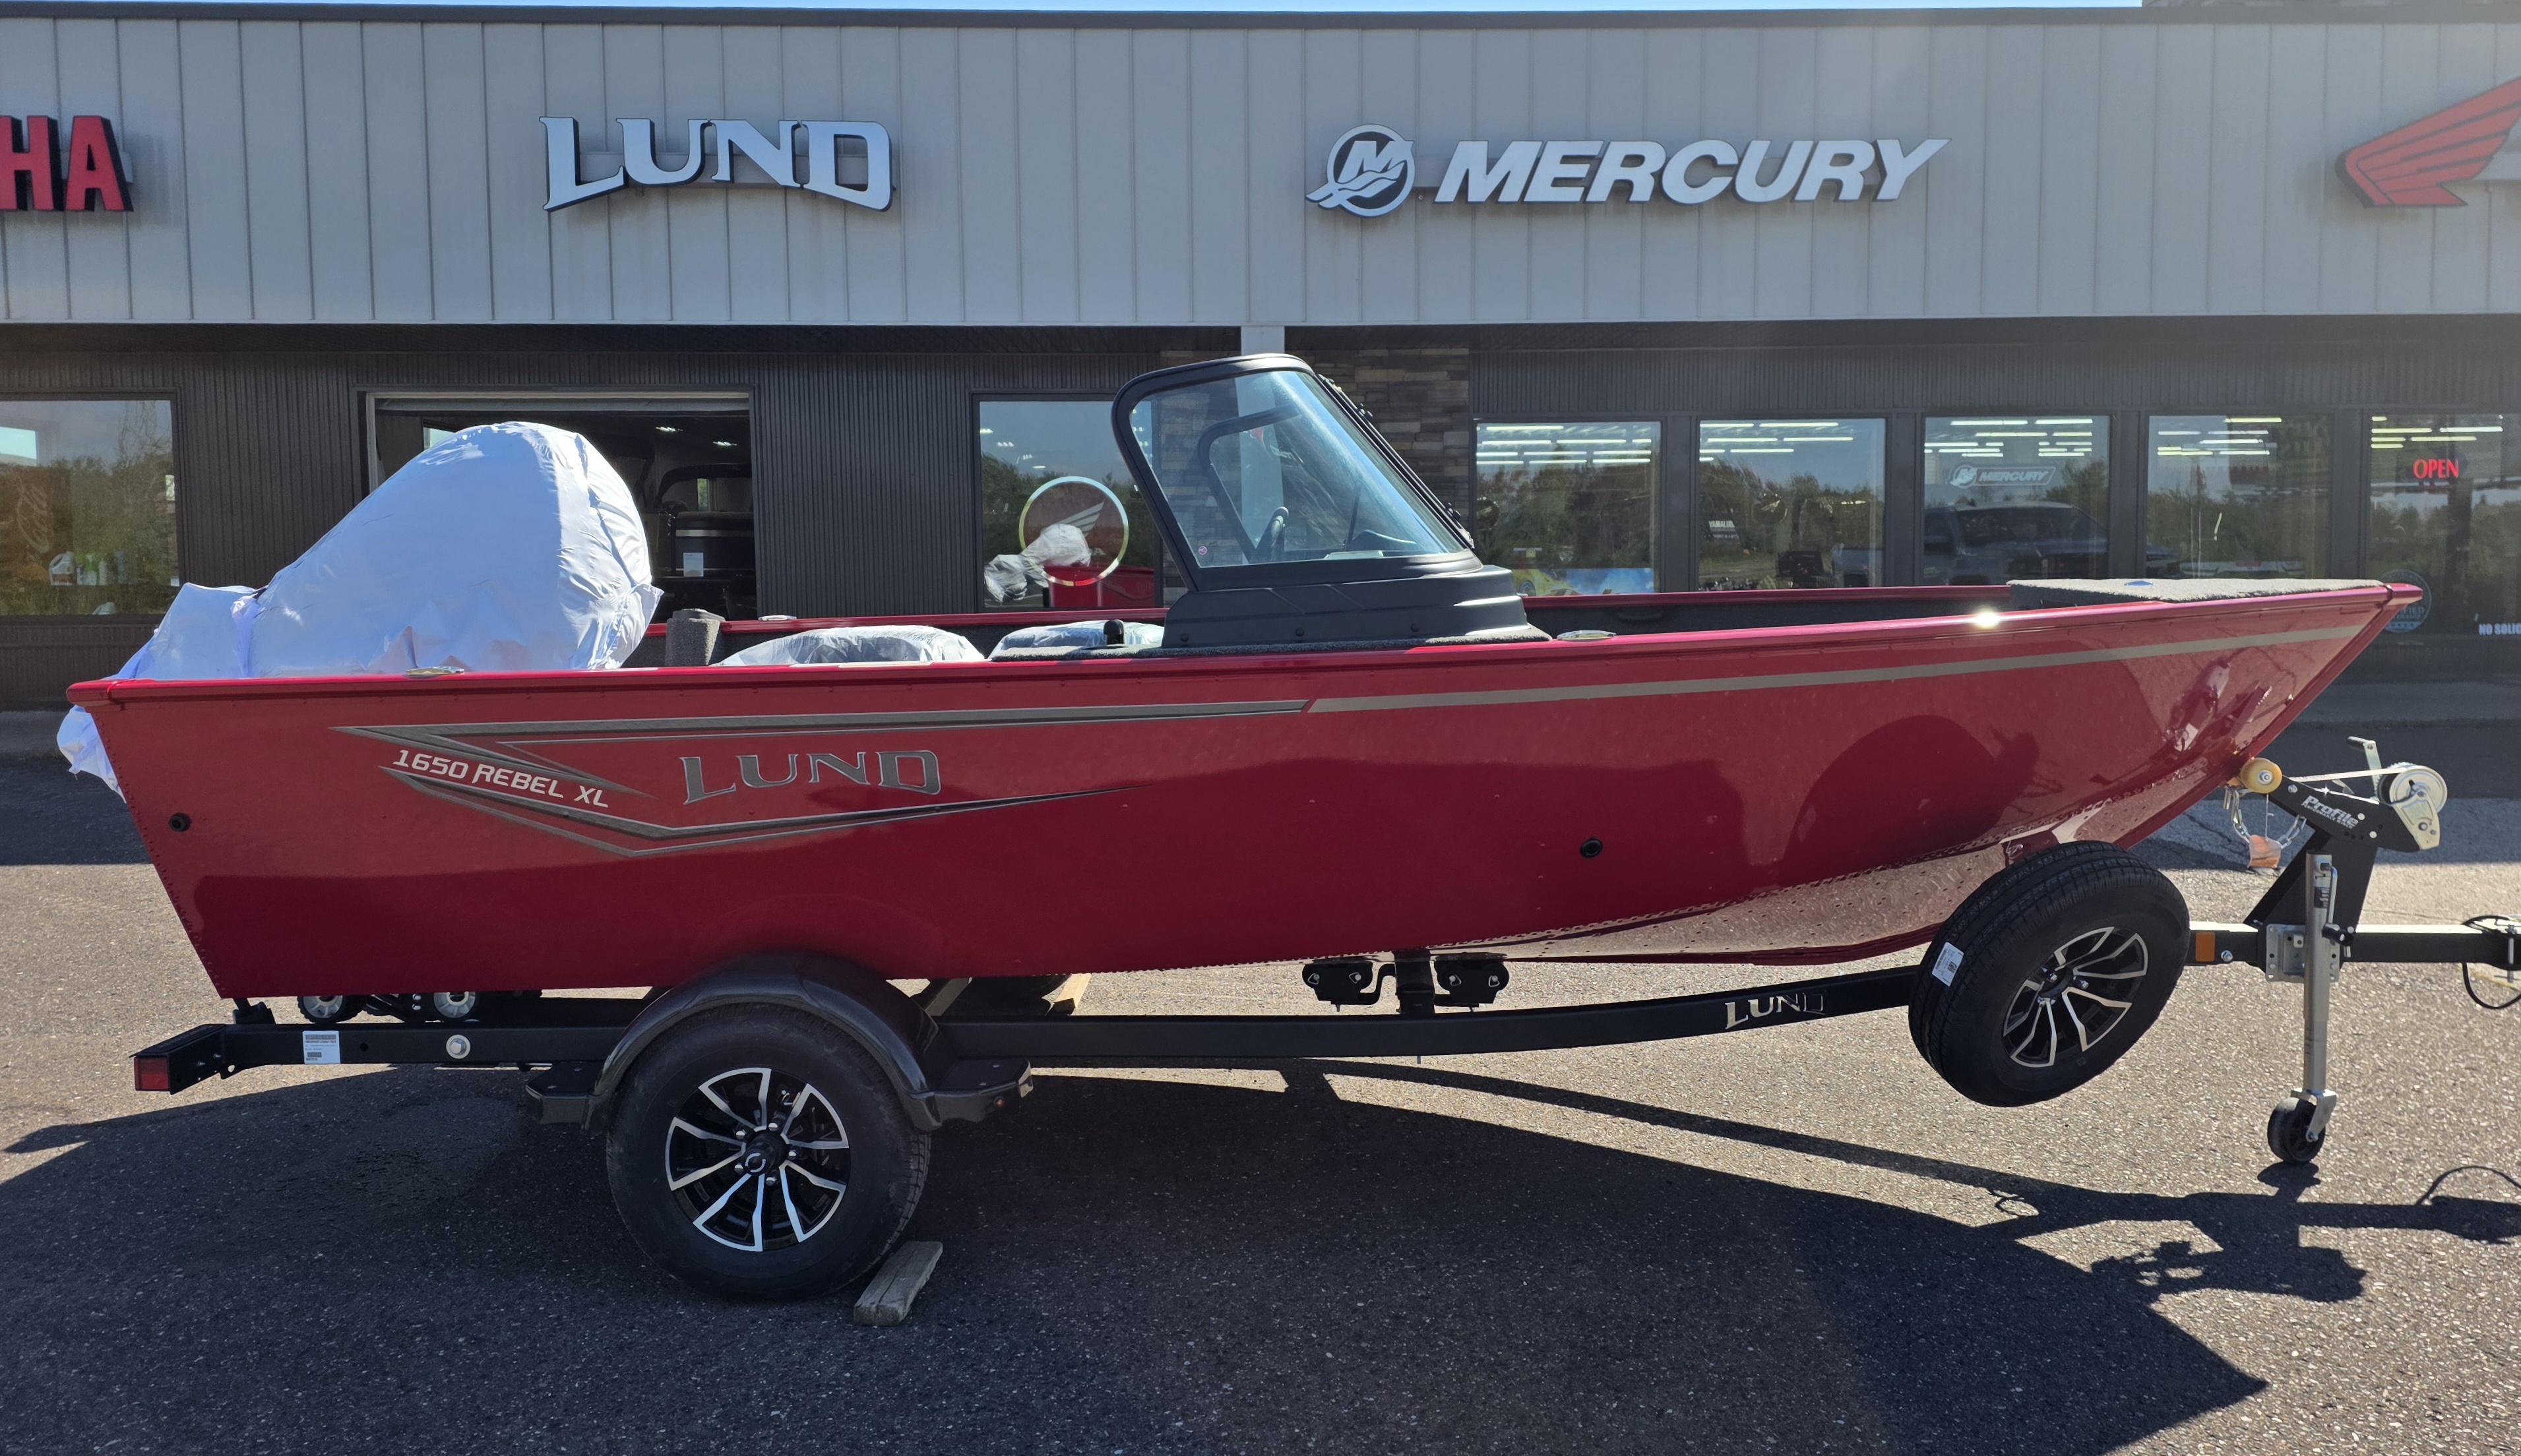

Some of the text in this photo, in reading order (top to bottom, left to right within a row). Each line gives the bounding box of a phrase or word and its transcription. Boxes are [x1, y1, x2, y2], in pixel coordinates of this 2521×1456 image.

[539, 116, 892, 212] LUND
[1433, 137, 1952, 206] MERCURY
[1979, 470, 2049, 482] MERCURY
[2413, 458, 2459, 479] OPEN
[2478, 624, 2493, 635] NO
[392, 750, 608, 808] 1650 REBEL XL
[680, 749, 942, 806] LUND
[2302, 795, 2359, 827] Profile
[1725, 992, 1826, 1029] LUND
